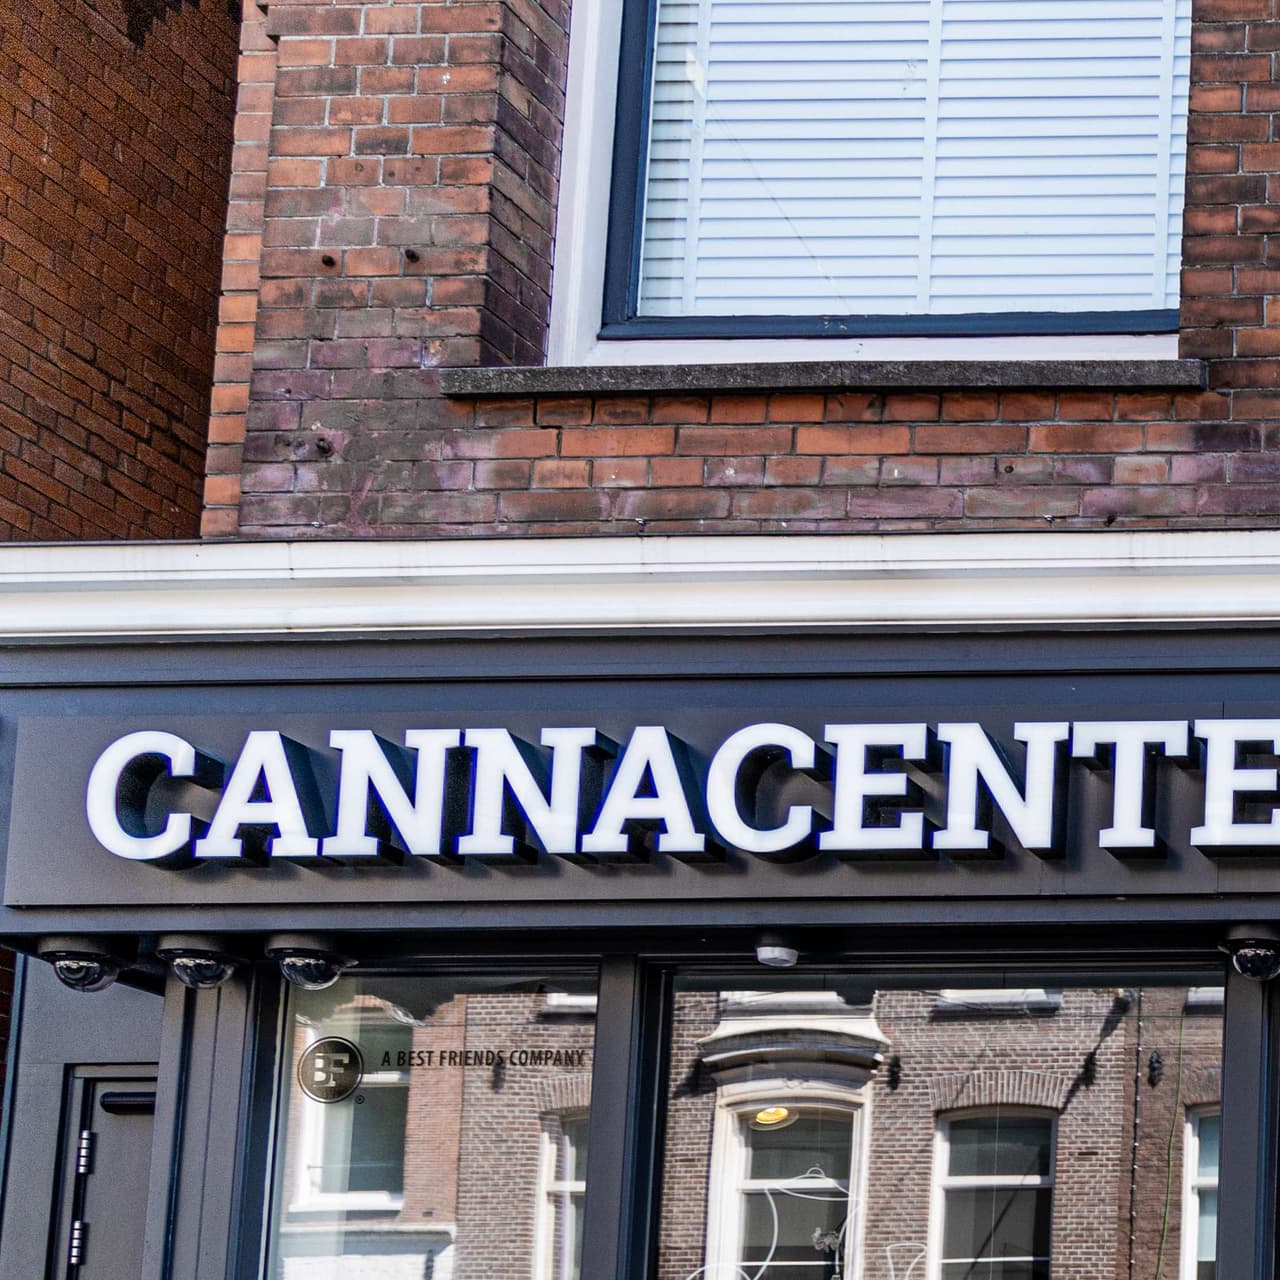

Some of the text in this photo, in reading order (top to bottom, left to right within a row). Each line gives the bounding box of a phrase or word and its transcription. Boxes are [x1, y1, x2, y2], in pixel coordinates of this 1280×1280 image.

[381, 1050, 584, 1067] A BEST FRIENDS COMPANY
